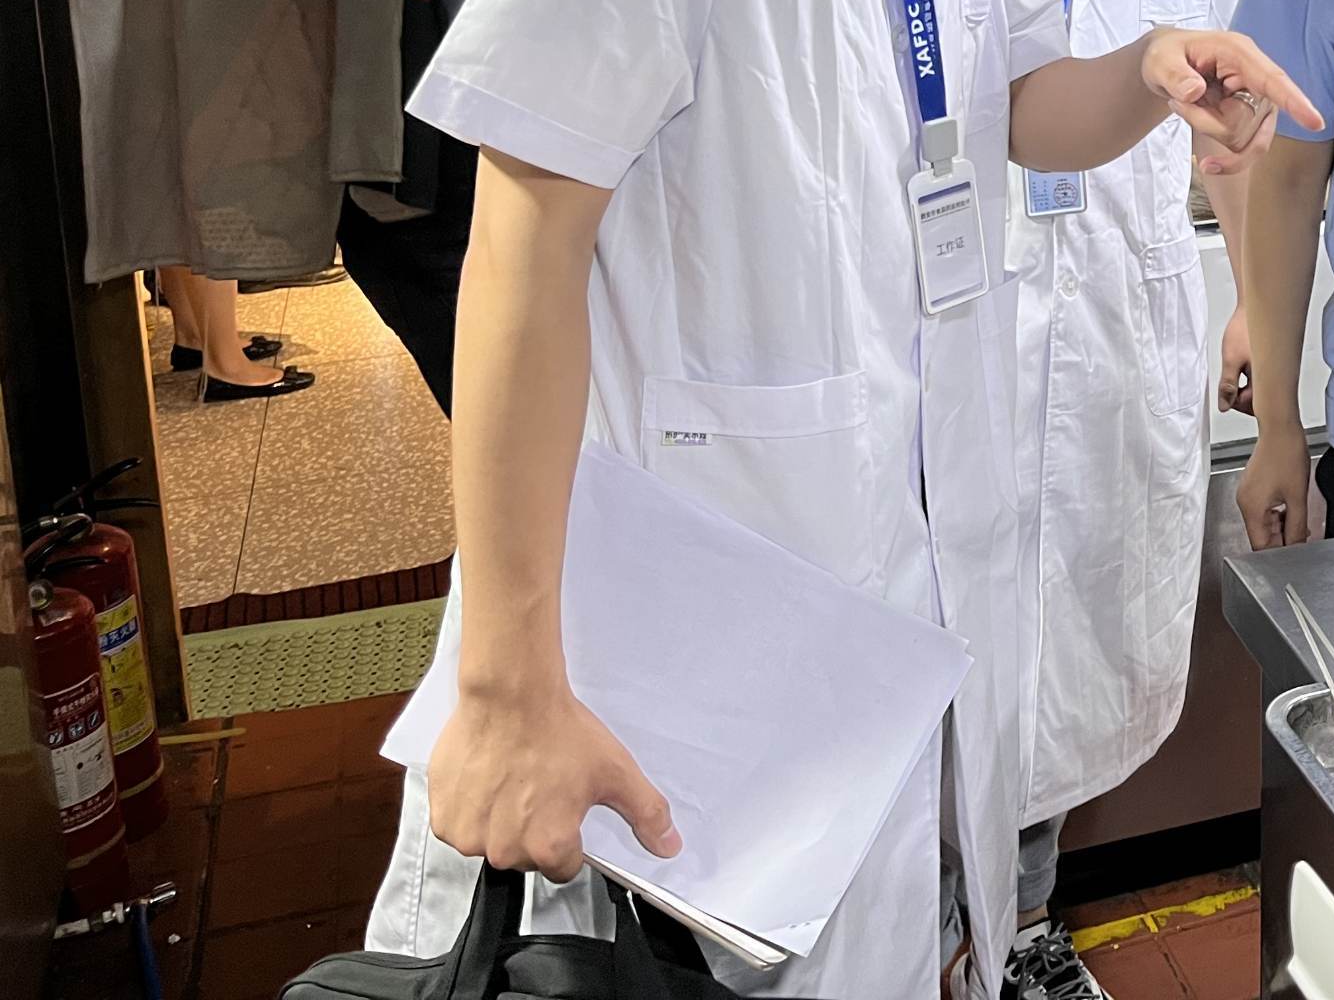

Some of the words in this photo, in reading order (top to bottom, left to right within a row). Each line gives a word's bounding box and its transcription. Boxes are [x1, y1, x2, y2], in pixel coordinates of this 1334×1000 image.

[908, 1, 936, 79] XAFDC
[936, 236, 965, 257] 工作证
